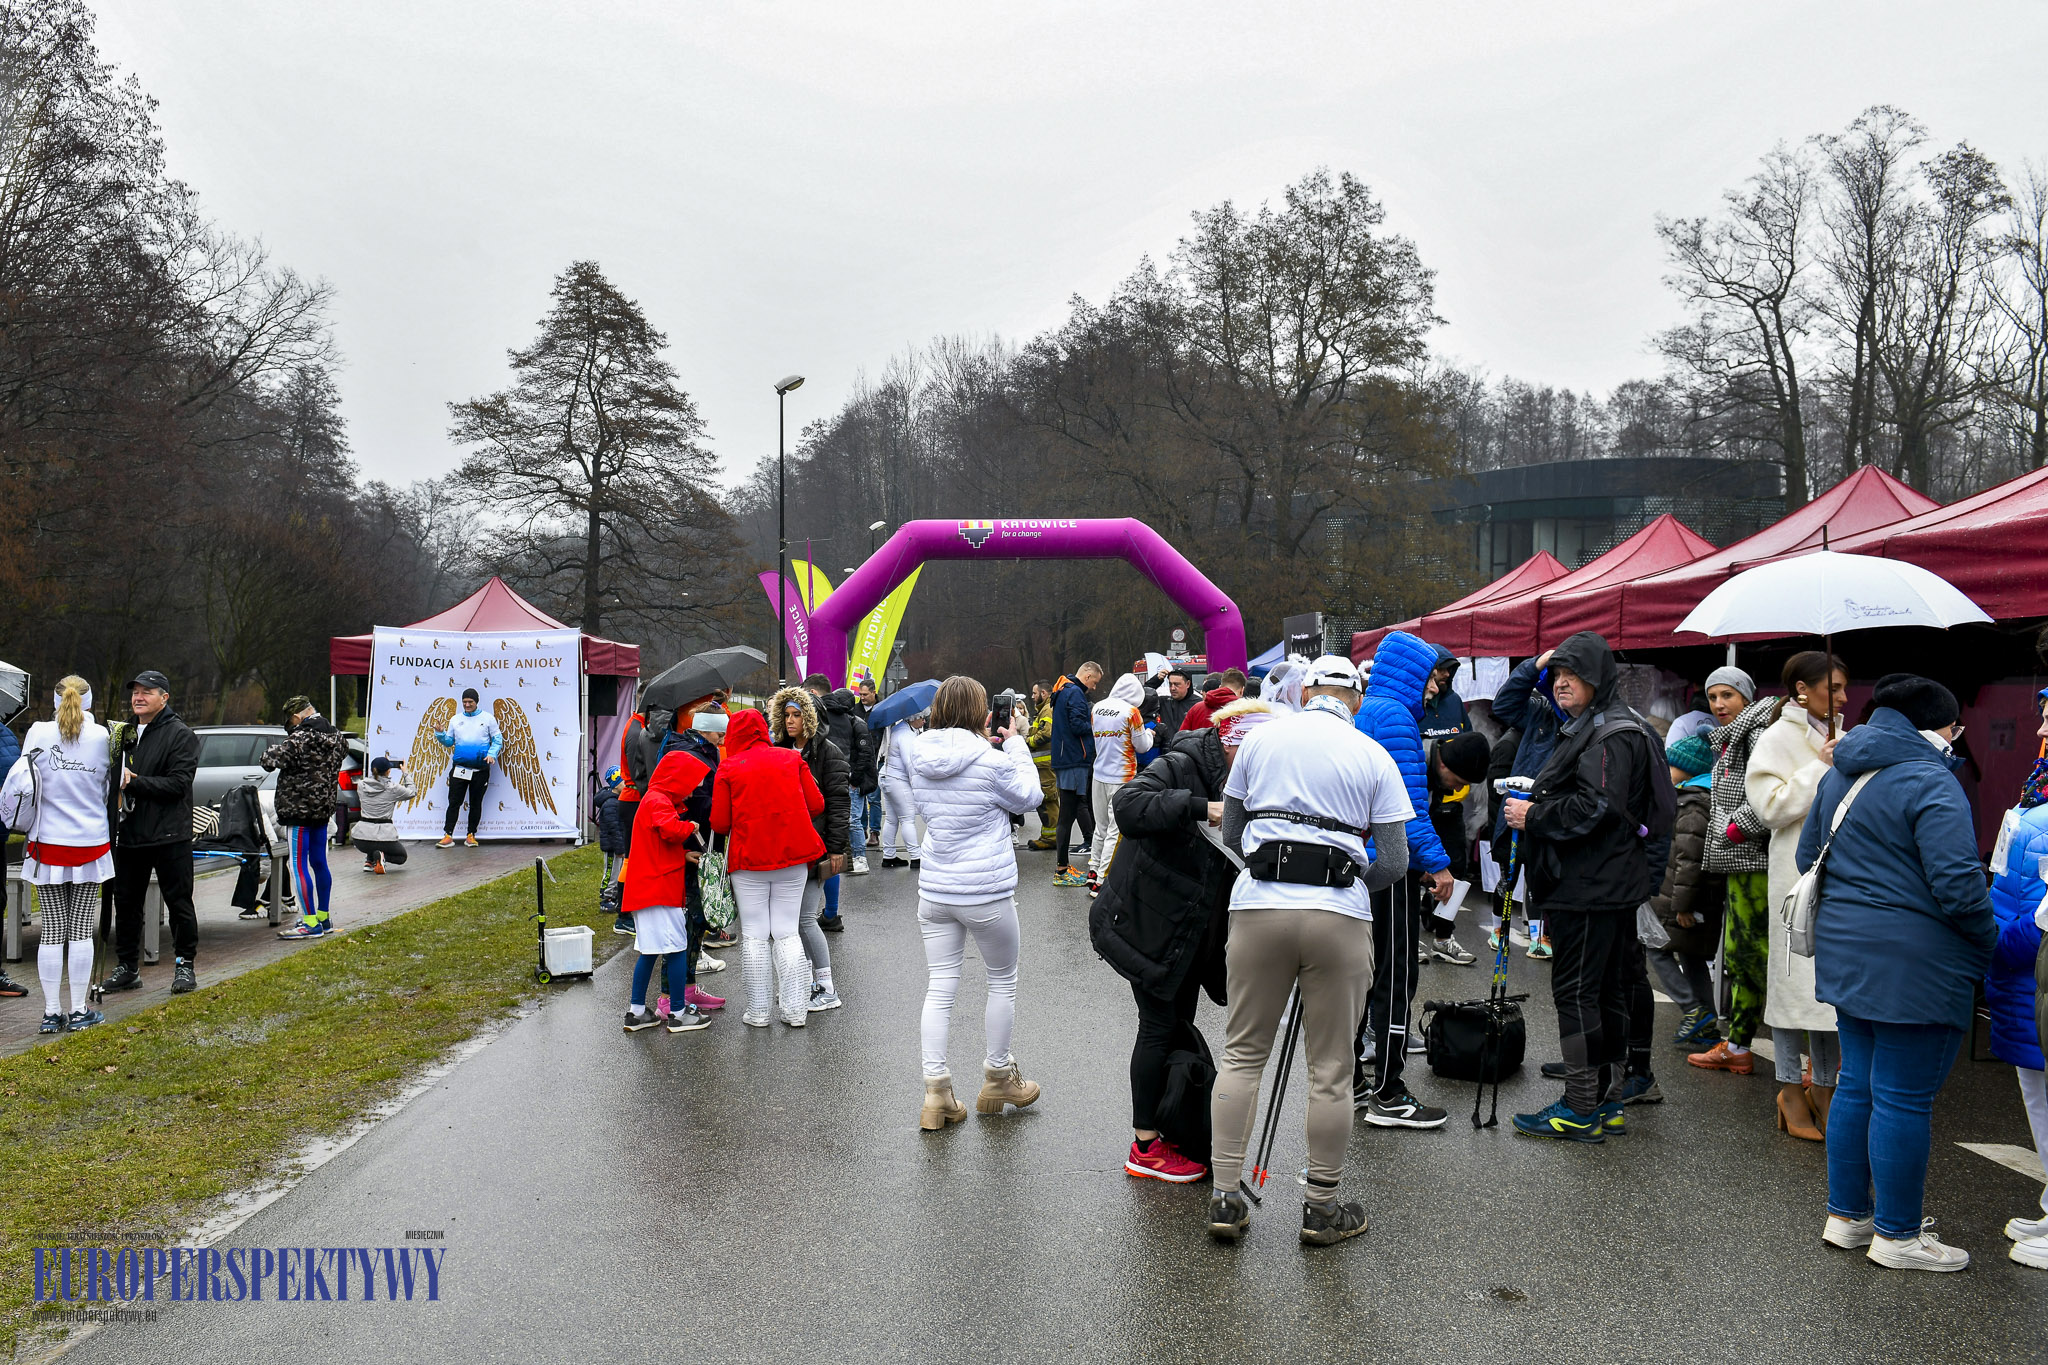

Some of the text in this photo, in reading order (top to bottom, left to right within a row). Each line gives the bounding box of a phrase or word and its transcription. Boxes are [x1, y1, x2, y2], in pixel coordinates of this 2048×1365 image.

[1001, 520, 1077, 529] KATOWICE
[861, 595, 889, 658] KATOWIC
[389, 655, 563, 672] FUNDACJA ŚLĄSKIE ANIOŁY
